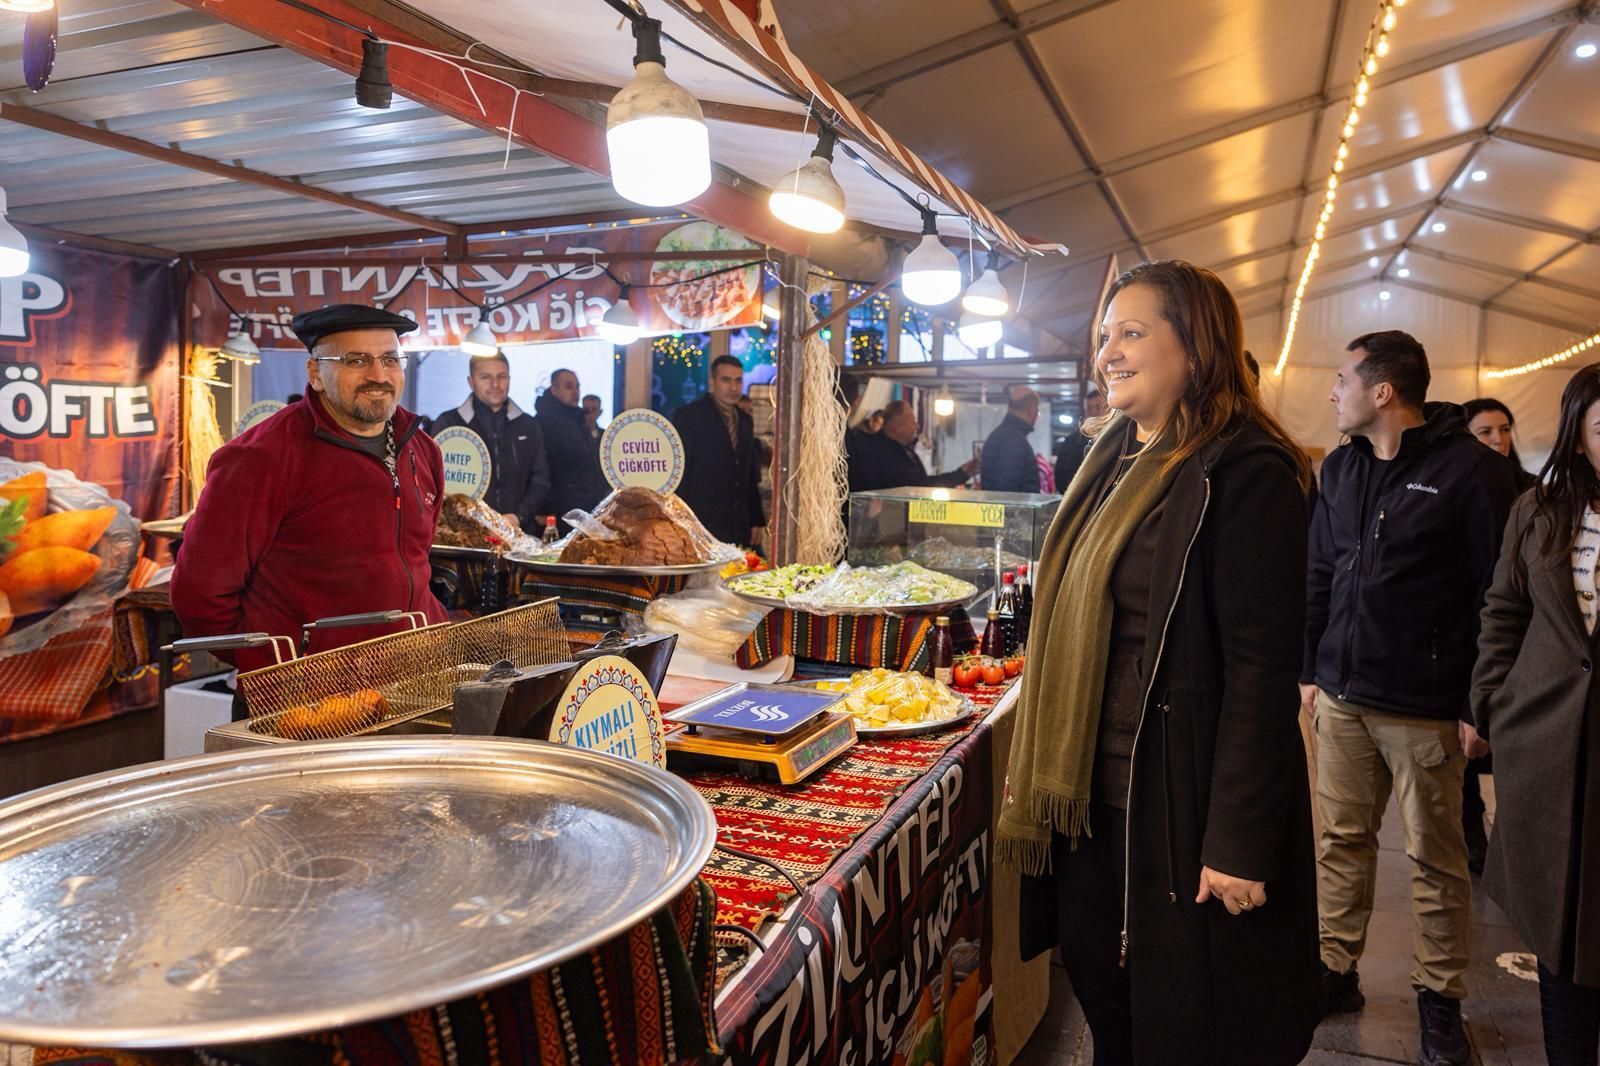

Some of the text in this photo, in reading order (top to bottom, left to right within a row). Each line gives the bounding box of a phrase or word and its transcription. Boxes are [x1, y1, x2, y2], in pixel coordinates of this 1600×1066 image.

[0, 273, 65, 337] P
[622, 438, 661, 454] CEVİZLİ
[444, 453, 471, 466] ANTEP
[618, 457, 668, 477] ÇİĞKÖFTE
[445, 468, 477, 485] ĞKÖFTE
[1412, 482, 1438, 493] Columbia
[574, 700, 635, 749] KIYMALI
[606, 728, 637, 760] İZLİ
[723, 763, 963, 1066] ZİANTEP
